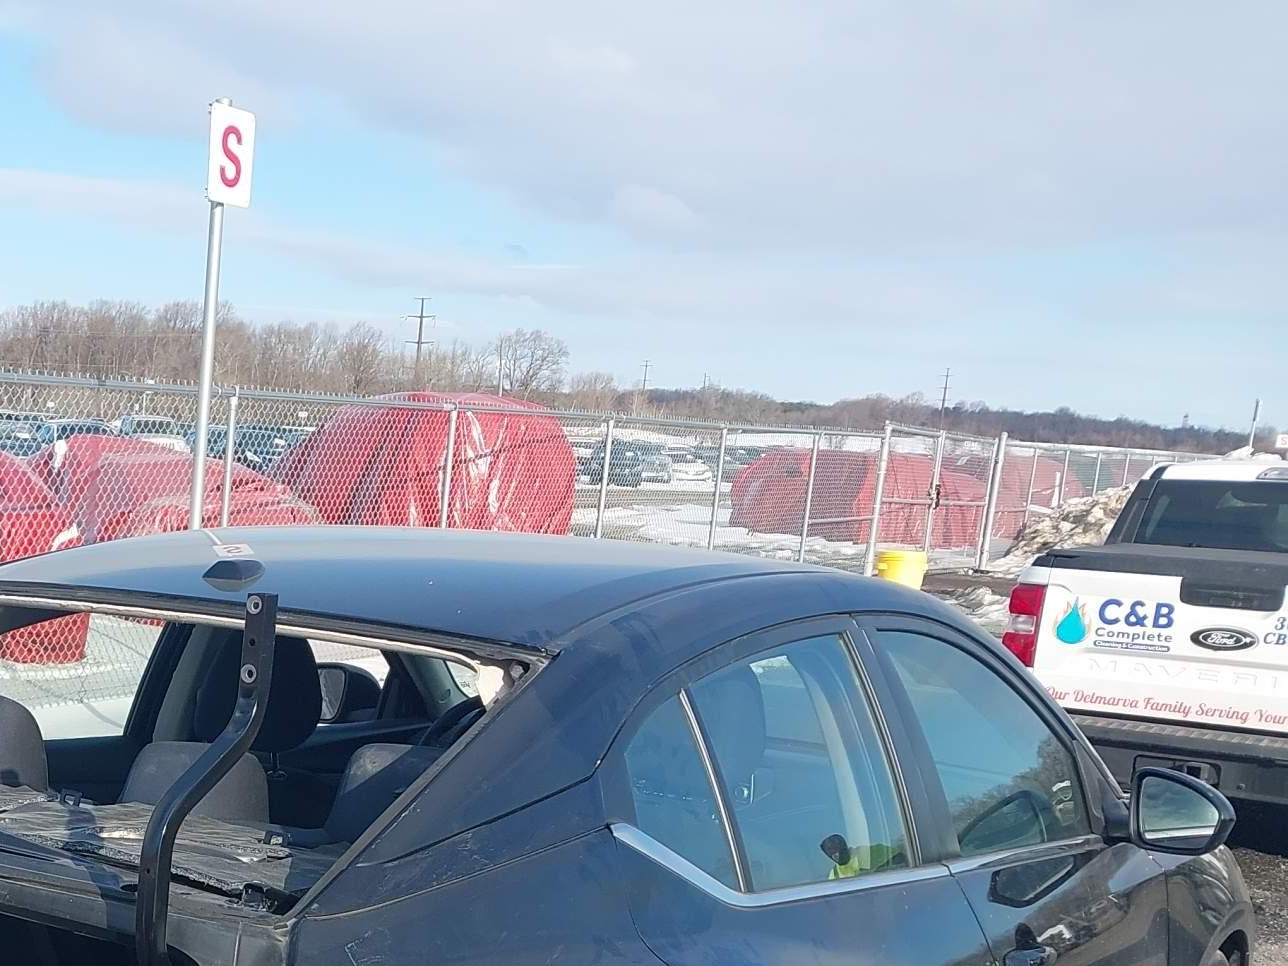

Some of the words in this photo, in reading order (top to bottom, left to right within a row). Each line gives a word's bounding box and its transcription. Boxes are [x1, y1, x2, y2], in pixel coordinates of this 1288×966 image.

[219, 124, 243, 188] S
[1098, 598, 1175, 629] C&B
[1095, 627, 1173, 643] Complete
[1207, 631, 1237, 645] Ford
[1073, 689, 1139, 708] Delmarva
[1143, 697, 1192, 718] Family
[1195, 702, 1250, 724] Serving
